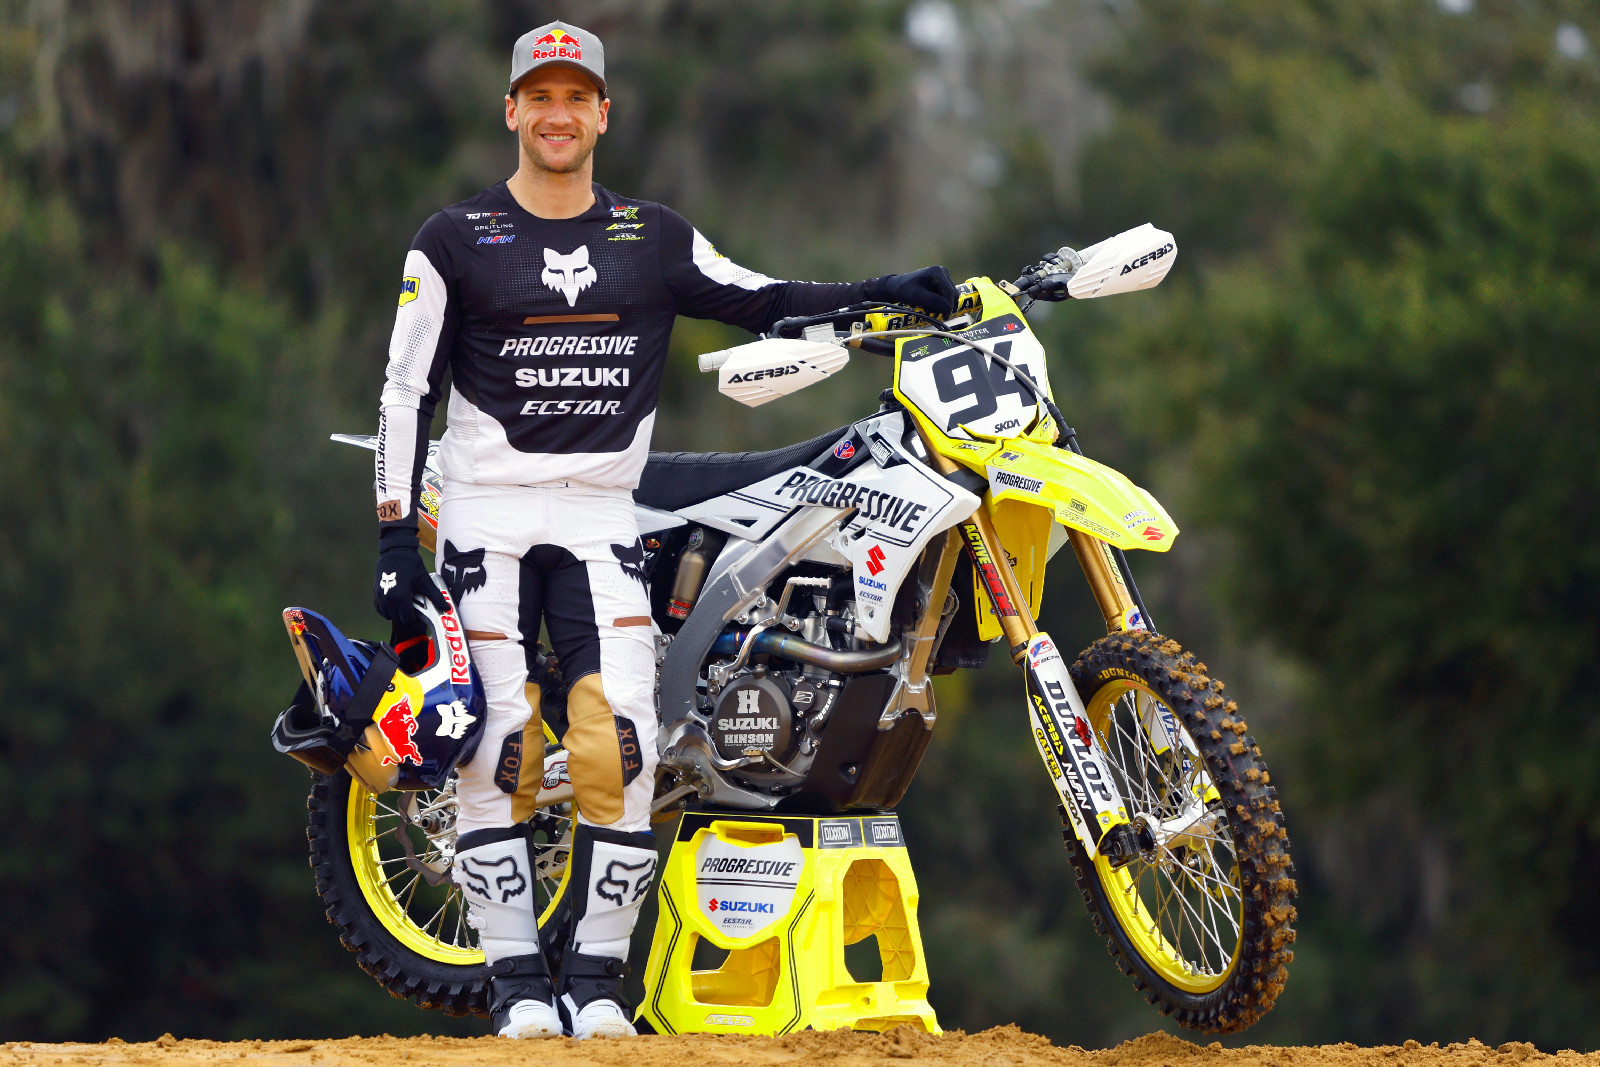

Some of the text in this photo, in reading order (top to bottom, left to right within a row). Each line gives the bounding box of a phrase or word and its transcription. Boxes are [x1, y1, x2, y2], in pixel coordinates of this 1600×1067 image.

[533, 47, 582, 60] Red Bull
[499, 336, 639, 357] PROGRESSIVE
[515, 368, 630, 387] SUZUKI
[931, 340, 1037, 432] 94
[519, 400, 625, 415] ECSTAR
[994, 419, 1021, 433] SKDA
[995, 471, 1043, 493] PROGRESSIVE
[774, 470, 928, 535] PROGRESSIVE
[859, 576, 887, 591] SUZUKI
[859, 590, 883, 602] ECSTAR
[444, 634, 470, 684] Red
[1101, 667, 1149, 686] DUNLOP
[718, 717, 779, 731] SUZUKI
[724, 734, 774, 744] HINSON
[1044, 680, 1112, 802] DUNLOP
[621, 727, 639, 771] FOX
[500, 742, 522, 783] FOX
[824, 827, 849, 841] DIXXON
[701, 857, 796, 876] PROGRESSIVE
[720, 900, 774, 913] SUZUKI
[723, 917, 753, 925] ECSTAR
